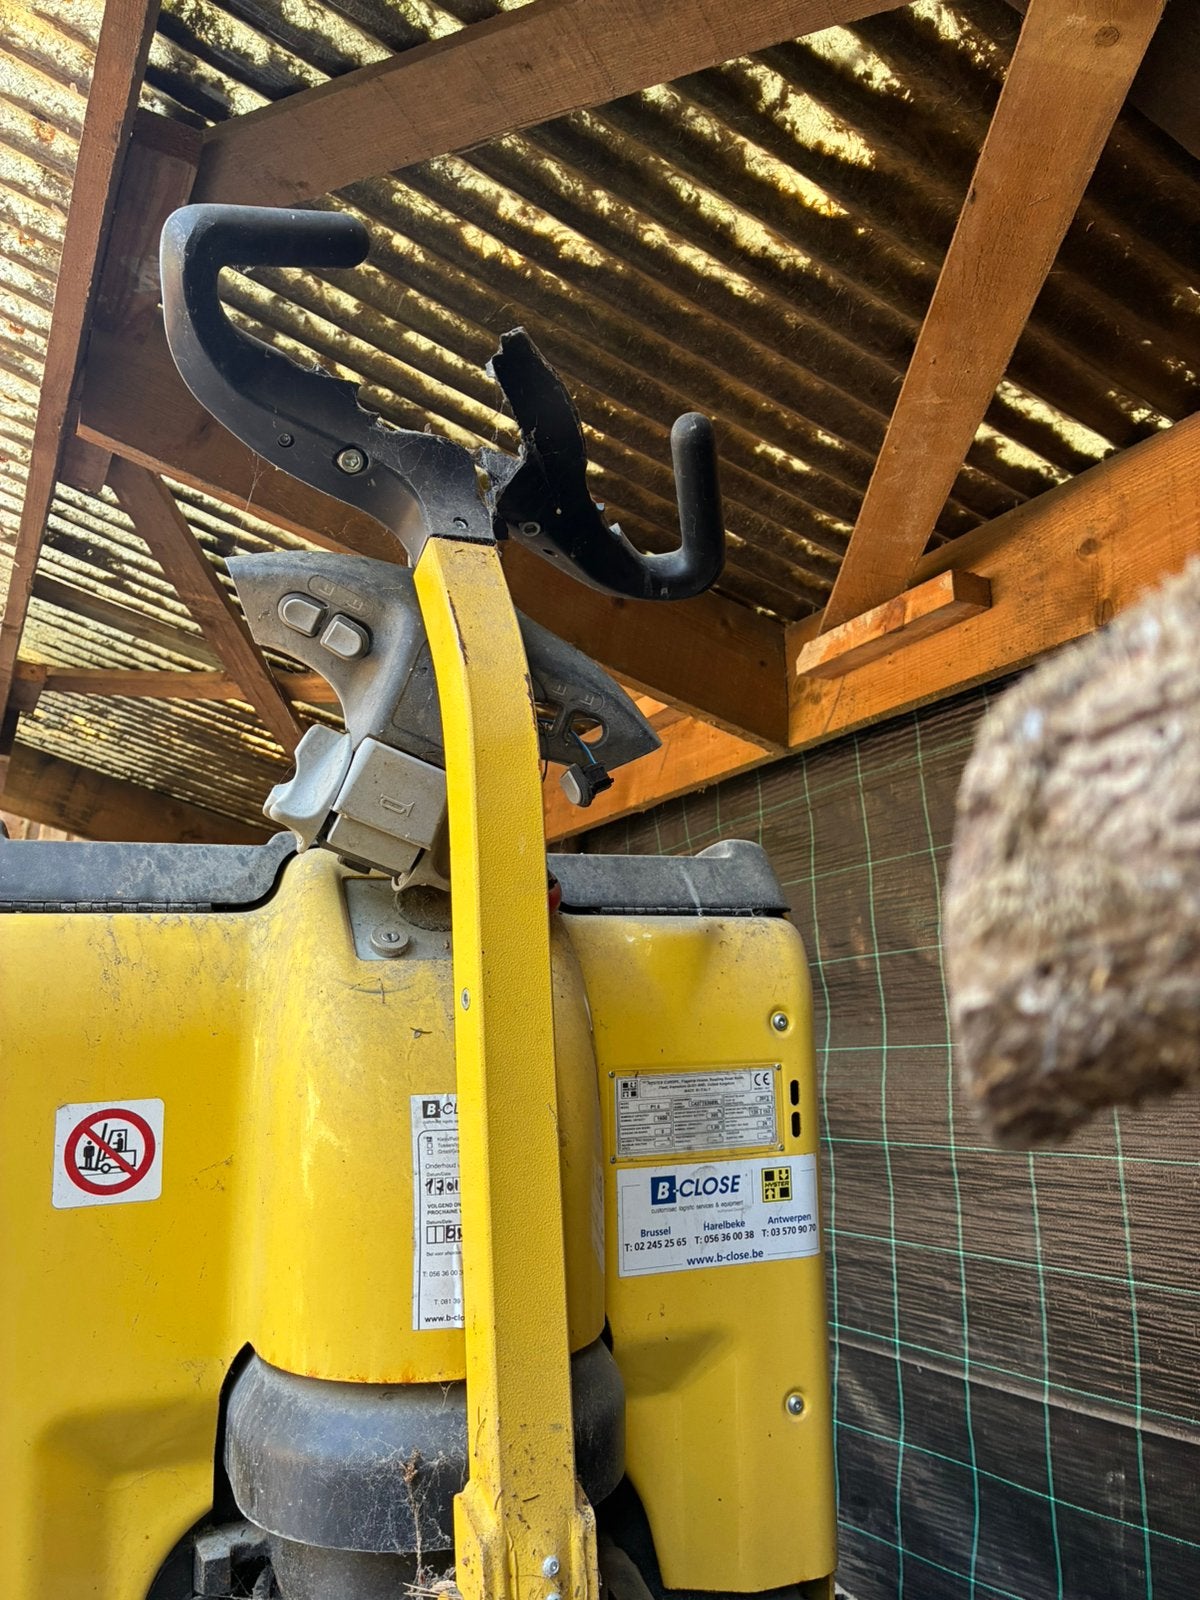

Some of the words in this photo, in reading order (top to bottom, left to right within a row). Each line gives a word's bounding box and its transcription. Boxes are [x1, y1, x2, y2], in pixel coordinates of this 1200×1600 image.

[656, 1174, 741, 1200] B-CLOSE
[704, 1220, 746, 1231] Harelbeke
[767, 1213, 811, 1225] Antwerpen
[640, 1226, 671, 1238] Brussel
[694, 1236, 703, 1244] T:
[704, 1234, 720, 1244] 056
[721, 1233, 731, 1242] 36
[732, 1232, 743, 1241] 00
[744, 1230, 755, 1239] 38
[761, 1229, 770, 1238] T:
[770, 1227, 782, 1237] 03
[782, 1226, 796, 1235] 570
[797, 1225, 808, 1234] 90
[808, 1223, 816, 1232] 70
[625, 1243, 633, 1252] T:
[634, 1242, 646, 1251] 02
[646, 1240, 663, 1249] 245
[664, 1239, 676, 1248] 25
[677, 1238, 687, 1247] 65
[687, 1248, 764, 1266] www.b-close.be
